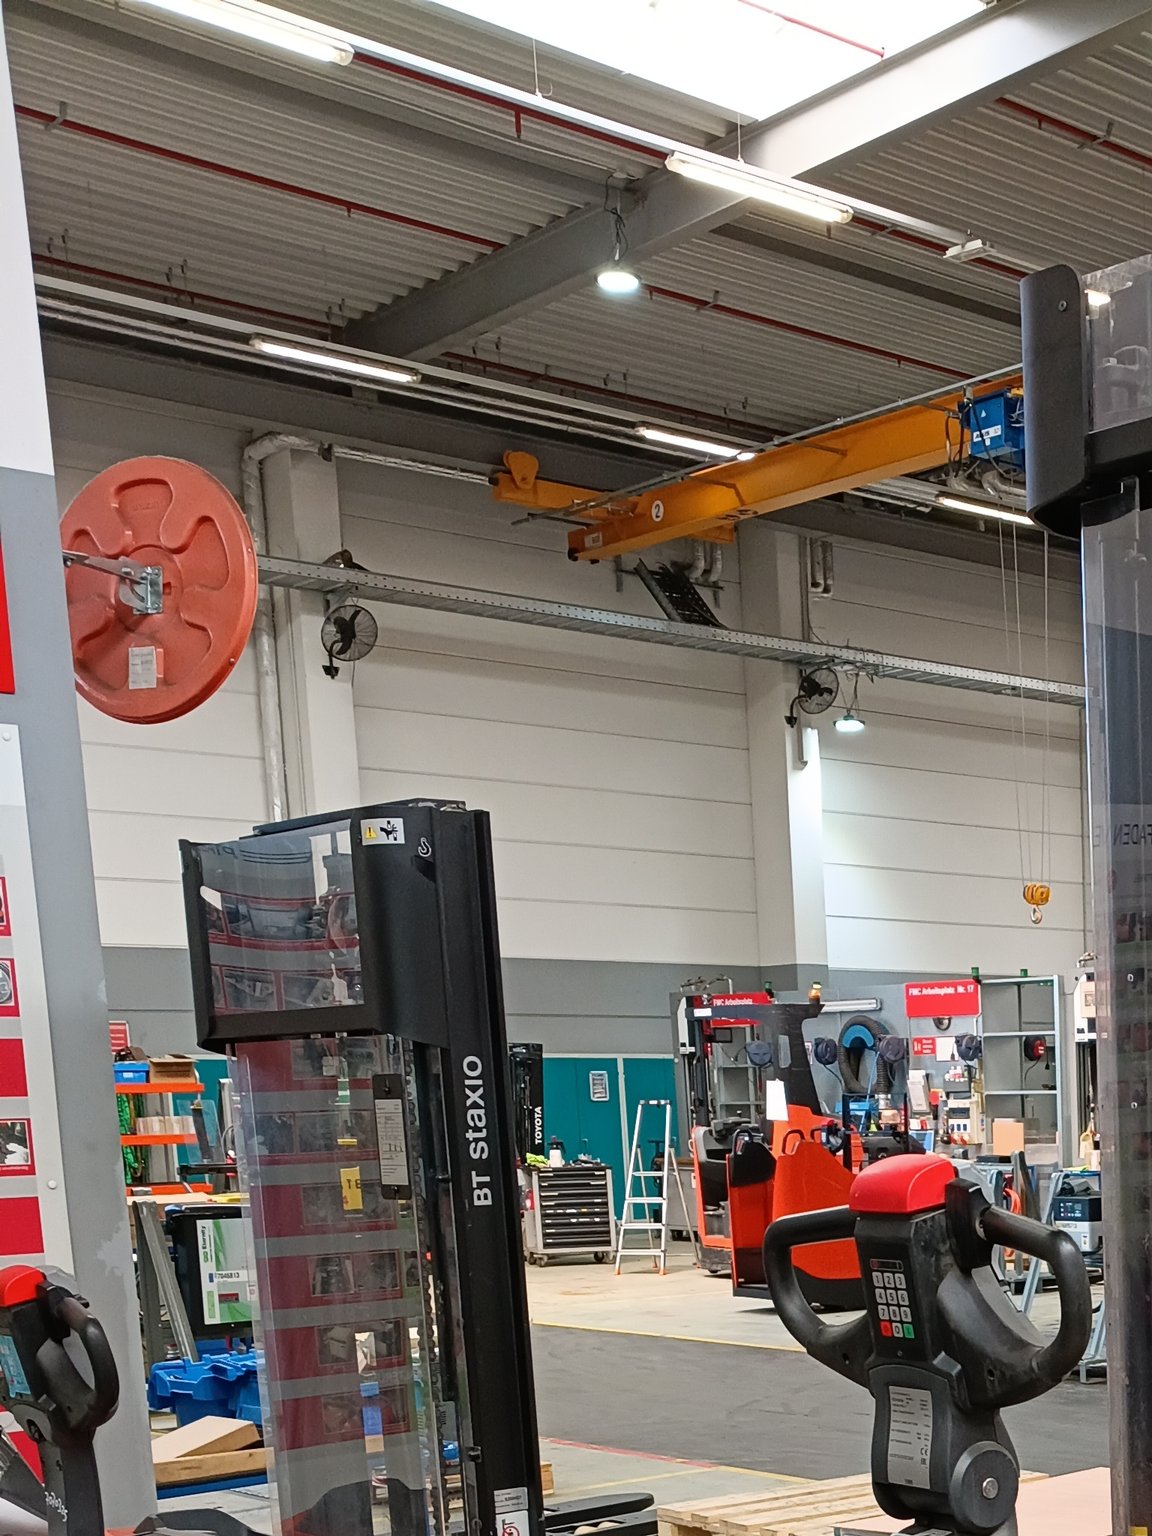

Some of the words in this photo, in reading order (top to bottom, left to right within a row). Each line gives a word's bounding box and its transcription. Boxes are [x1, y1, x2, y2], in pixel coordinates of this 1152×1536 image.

[654, 503, 661, 519] 2
[534, 1106, 543, 1145] TOYOTA
[471, 1171, 493, 1206] BT
